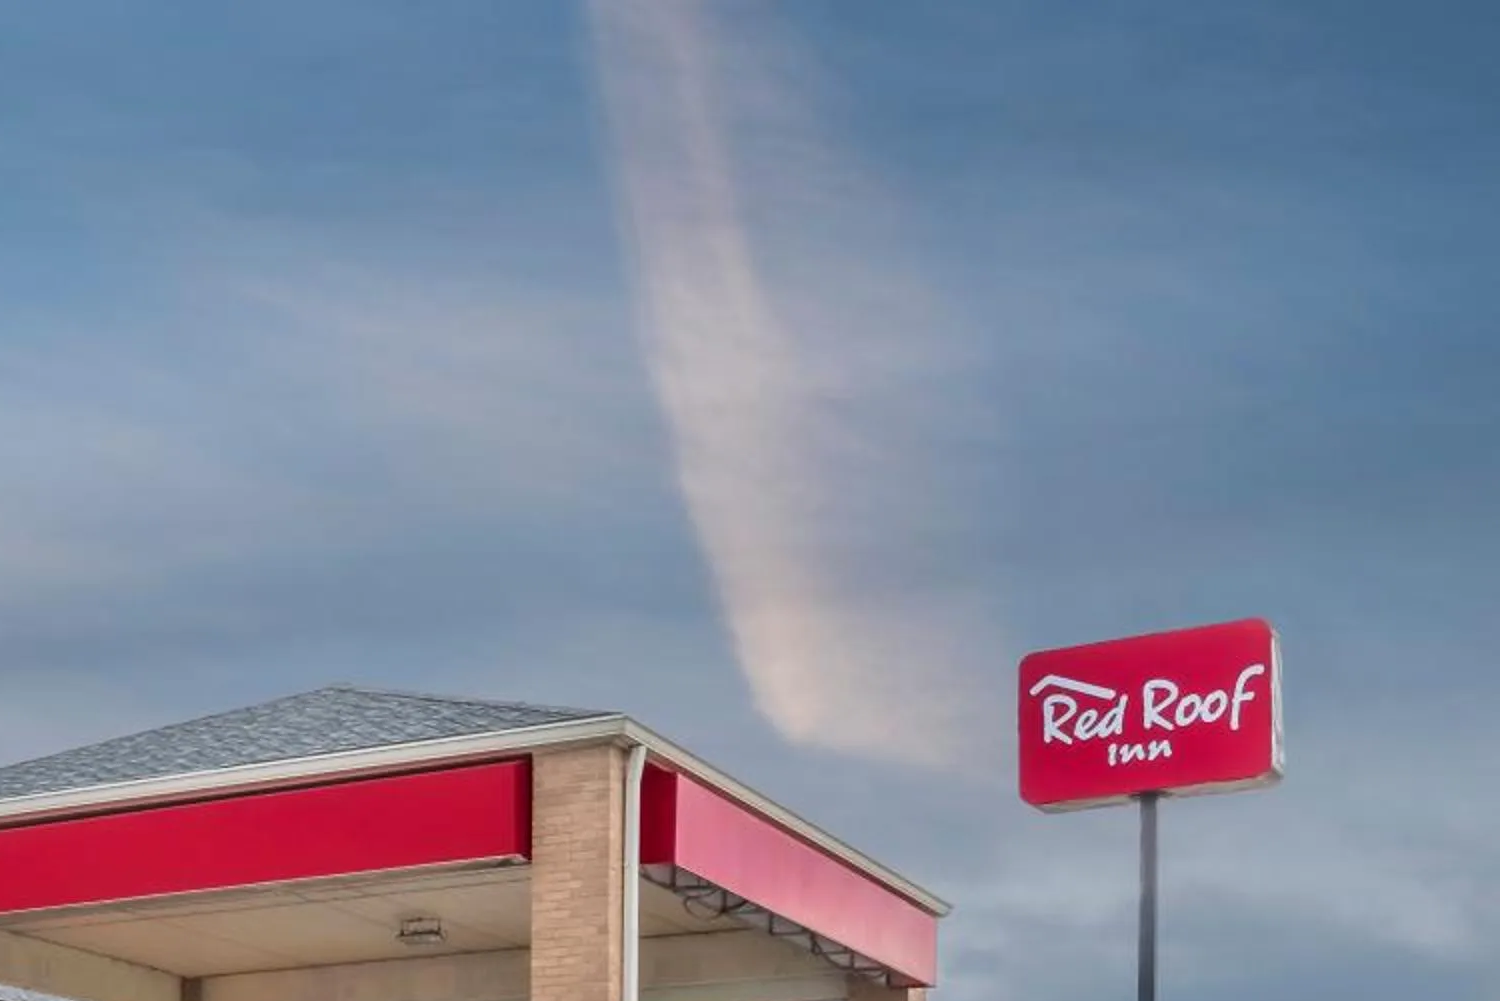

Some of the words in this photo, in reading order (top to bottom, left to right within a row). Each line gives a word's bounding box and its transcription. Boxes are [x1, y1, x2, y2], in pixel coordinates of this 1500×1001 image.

[1043, 694, 1128, 745] Red
[1143, 664, 1265, 731] Roof
[1107, 739, 1173, 766] inn
